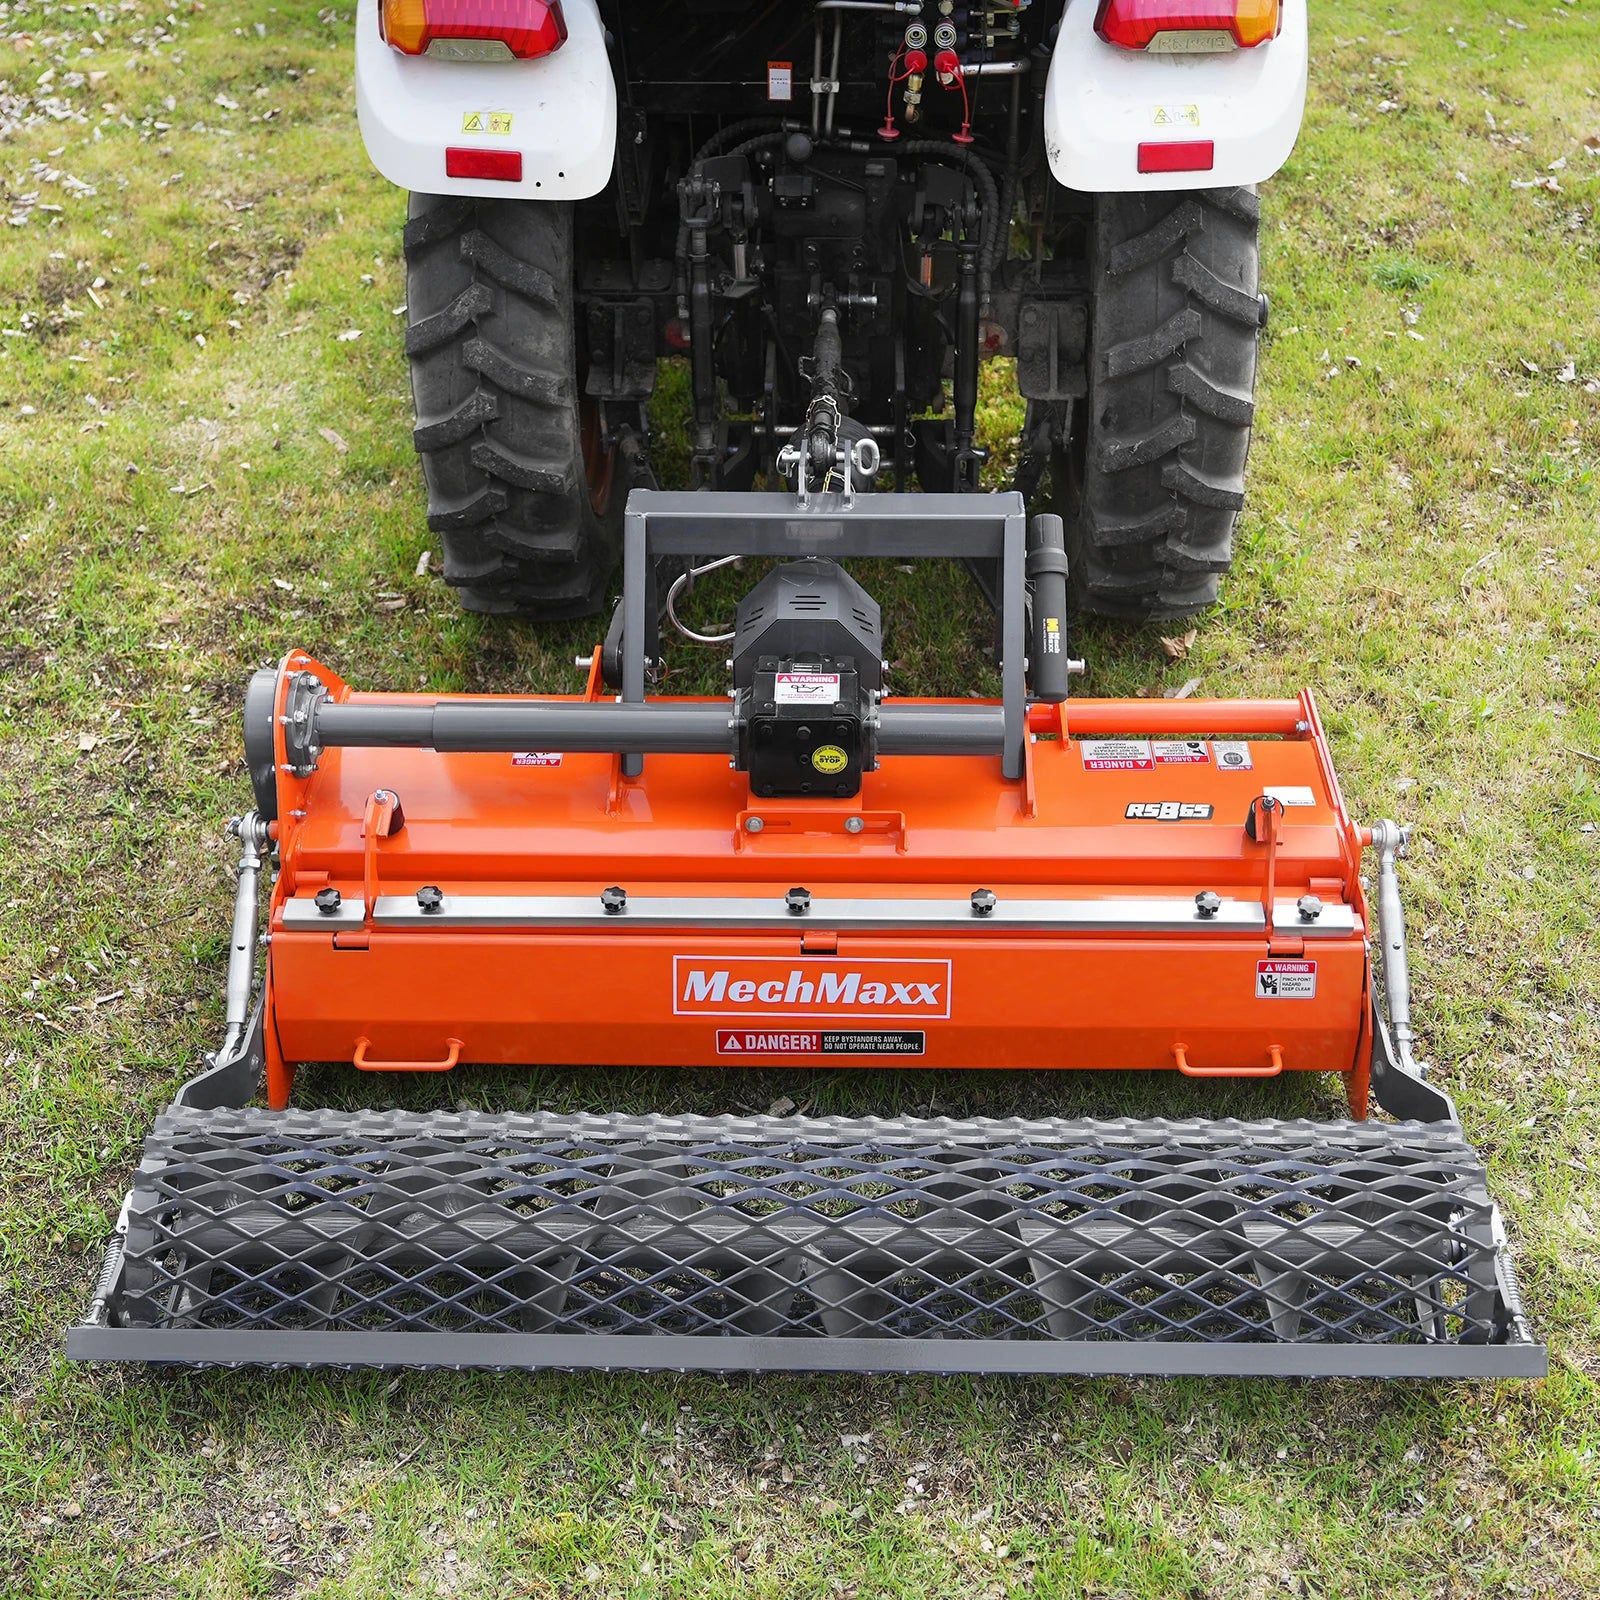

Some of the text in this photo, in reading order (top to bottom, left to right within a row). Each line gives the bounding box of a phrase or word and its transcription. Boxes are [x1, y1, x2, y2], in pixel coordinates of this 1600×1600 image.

[1090, 760, 1134, 769] DANGER
[1275, 963, 1309, 972] WARNING
[683, 970, 942, 1005] MechMaxx
[745, 1034, 817, 1050] DANGER!
